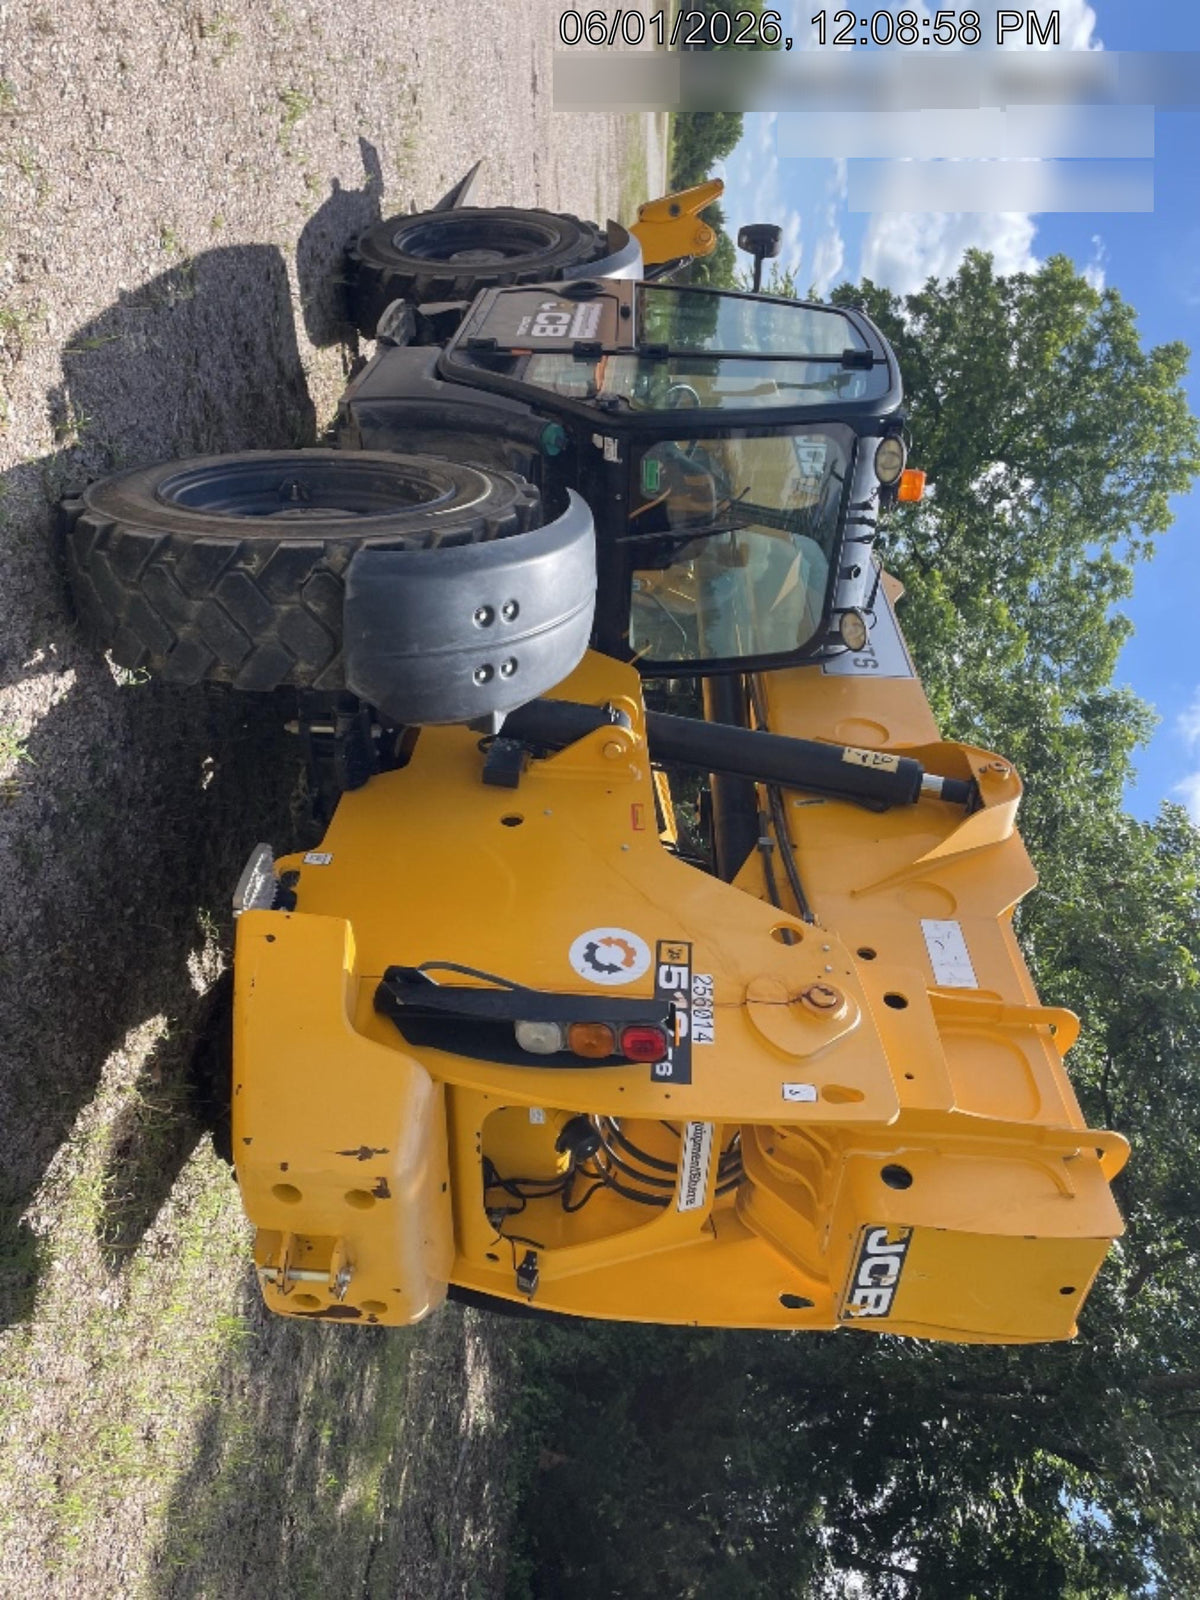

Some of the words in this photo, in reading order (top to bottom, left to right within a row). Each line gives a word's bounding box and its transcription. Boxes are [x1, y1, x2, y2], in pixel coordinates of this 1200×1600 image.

[693, 975, 714, 1042] 256014
[686, 1121, 706, 1206] uipmentShare
[849, 1229, 906, 1317] JCB
